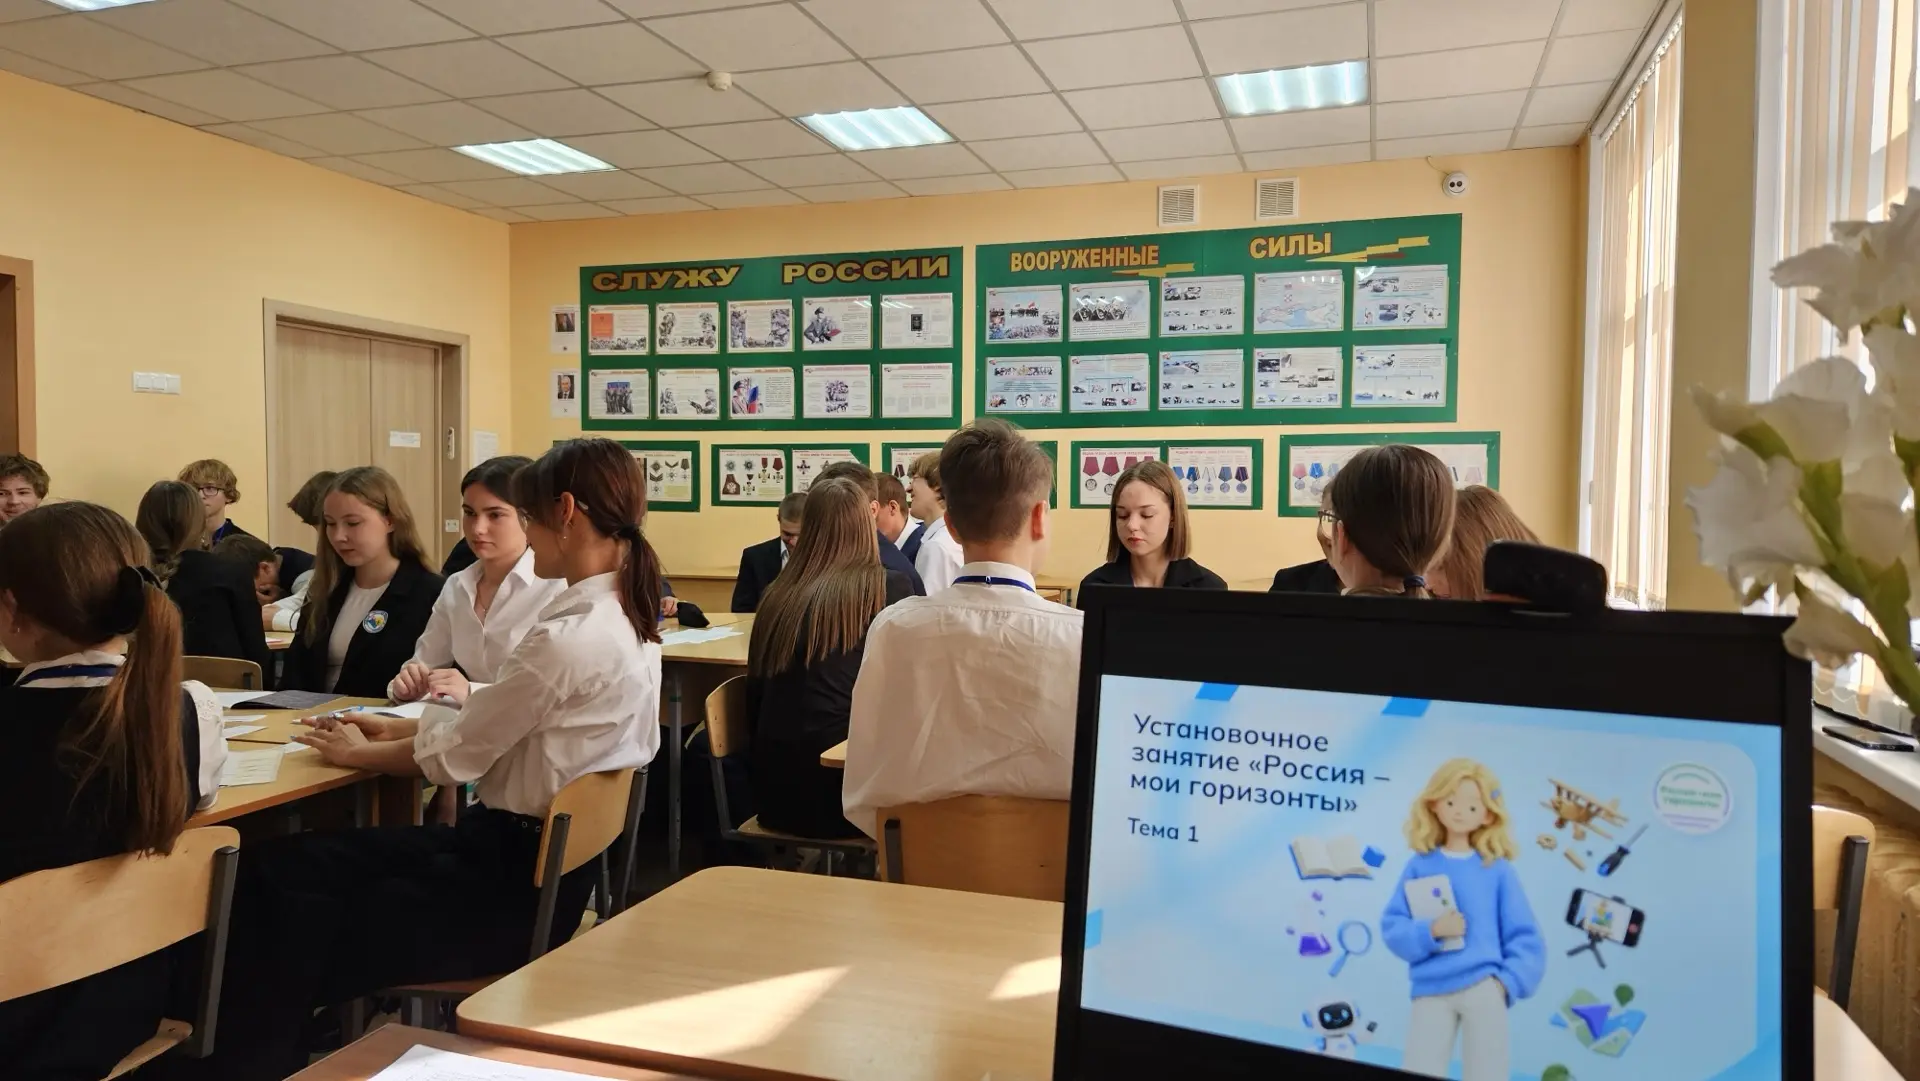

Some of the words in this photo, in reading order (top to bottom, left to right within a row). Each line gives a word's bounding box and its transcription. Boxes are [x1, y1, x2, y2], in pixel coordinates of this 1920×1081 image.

[1010, 245, 1160, 272] ВООРУЖЕННЫЕ
[1250, 232, 1332, 259] СИЛЫ
[591, 264, 743, 291] СЛУЖУ
[781, 255, 950, 285] РОССИИ
[1133, 713, 1329, 752] Установочное
[1131, 746, 1240, 772] занятие
[1249, 754, 1365, 785] «Россия
[1130, 773, 1180, 794] мои
[1189, 780, 1358, 812] горизонты»
[1127, 817, 1179, 840] Тема
[1187, 825, 1199, 842] 1
